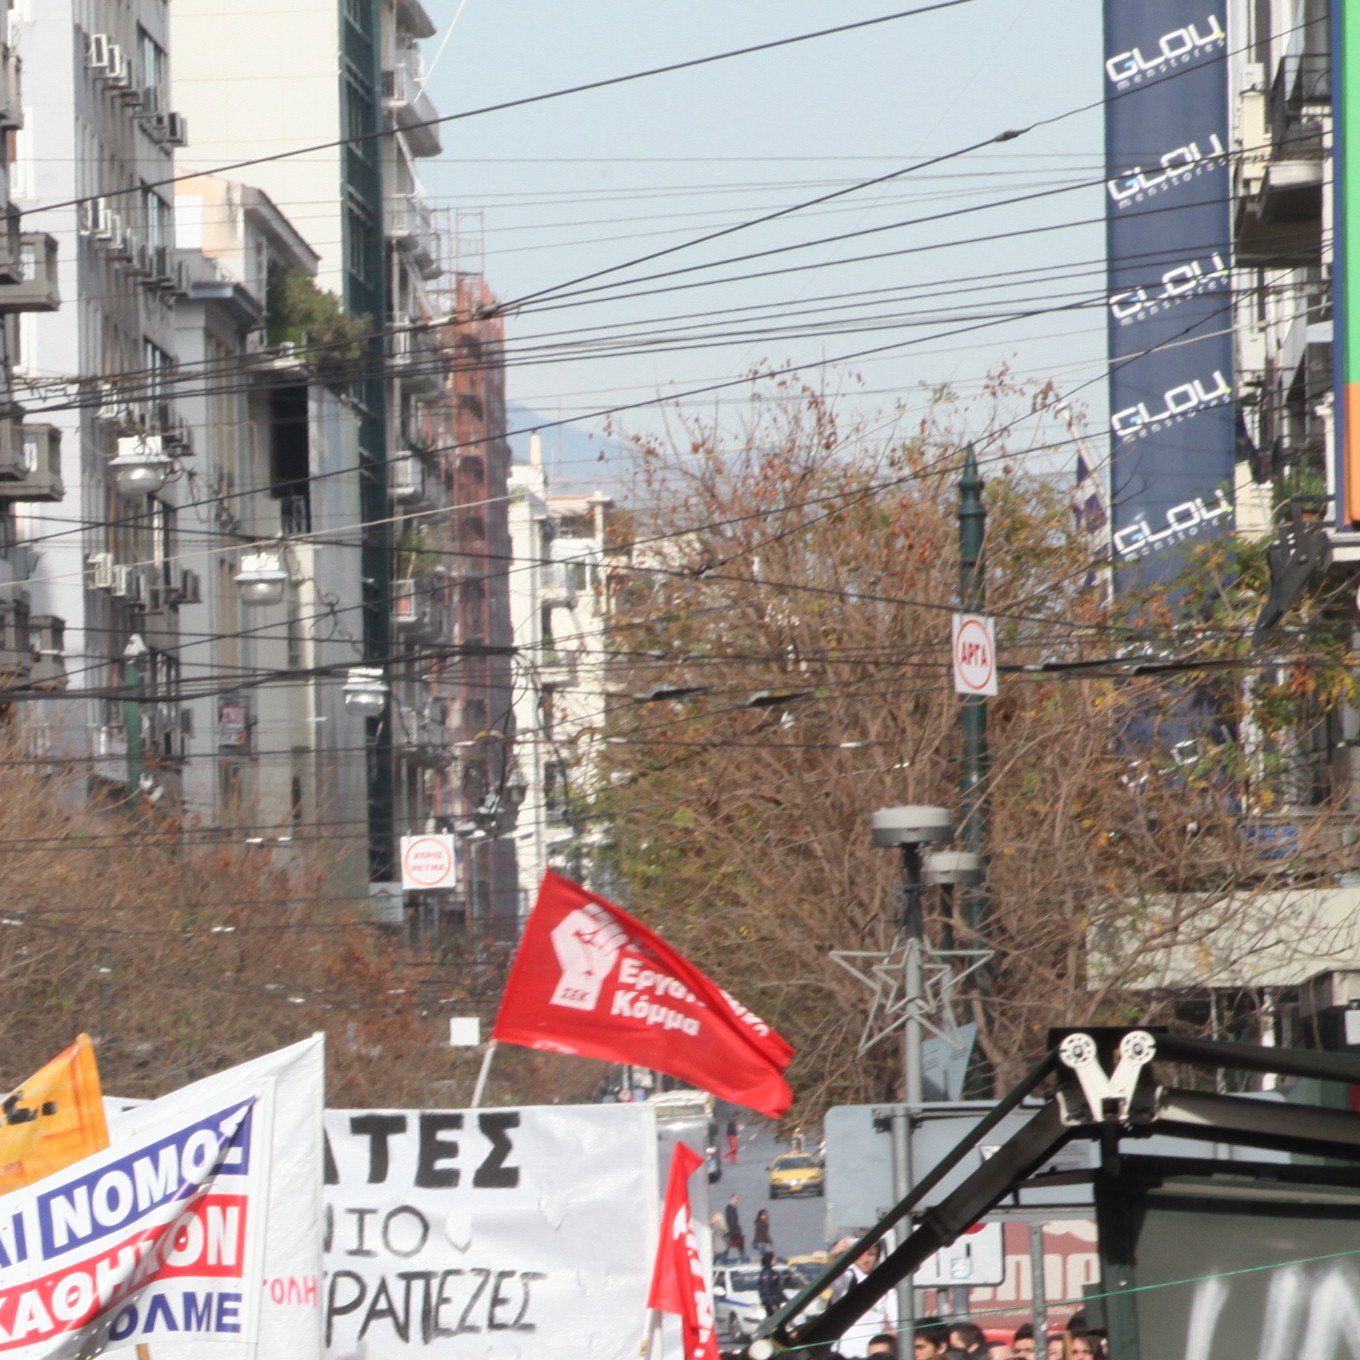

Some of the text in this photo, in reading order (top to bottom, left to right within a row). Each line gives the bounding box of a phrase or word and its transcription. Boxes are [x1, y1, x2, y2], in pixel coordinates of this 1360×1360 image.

[610, 989, 702, 1037] Κόμμα
[109, 1290, 242, 1342] ΟΛΜΕ
[323, 1267, 548, 1349] ΡΑΠΕΖΕΣ
